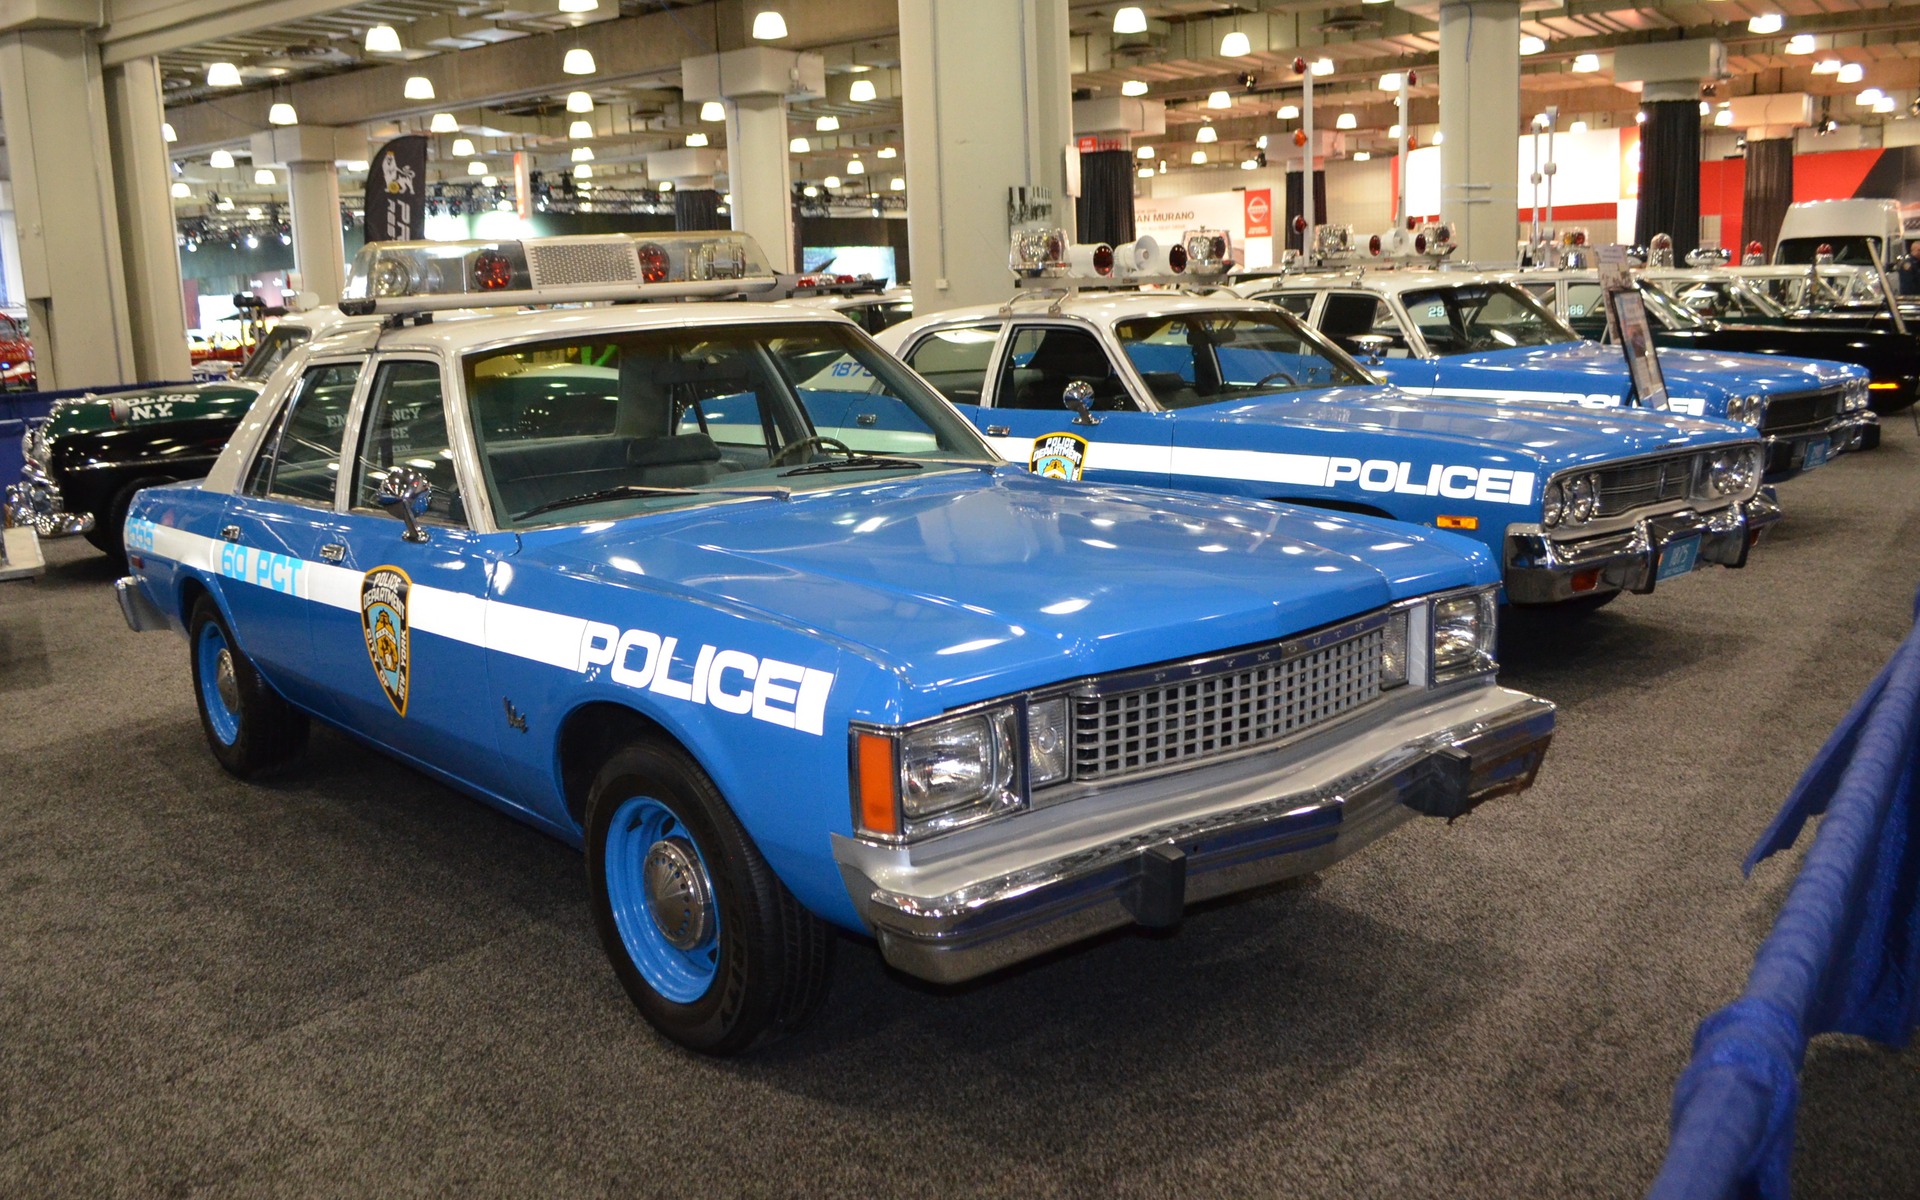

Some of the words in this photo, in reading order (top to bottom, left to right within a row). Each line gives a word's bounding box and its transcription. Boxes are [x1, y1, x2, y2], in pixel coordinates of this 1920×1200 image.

[1153, 211, 1195, 221] MURANO
[131, 402, 174, 420] N.Y.
[1045, 437, 1076, 450] POLICE
[1325, 456, 1515, 504] POLICE
[221, 542, 248, 581] 60
[256, 550, 303, 596] PCT
[372, 572, 402, 594] POLICE
[363, 587, 406, 620] DEPARTMENT
[366, 628, 380, 662] CITY
[379, 669, 391, 688] OF
[397, 671, 406, 700] NEW
[578, 620, 806, 730] POLICE
